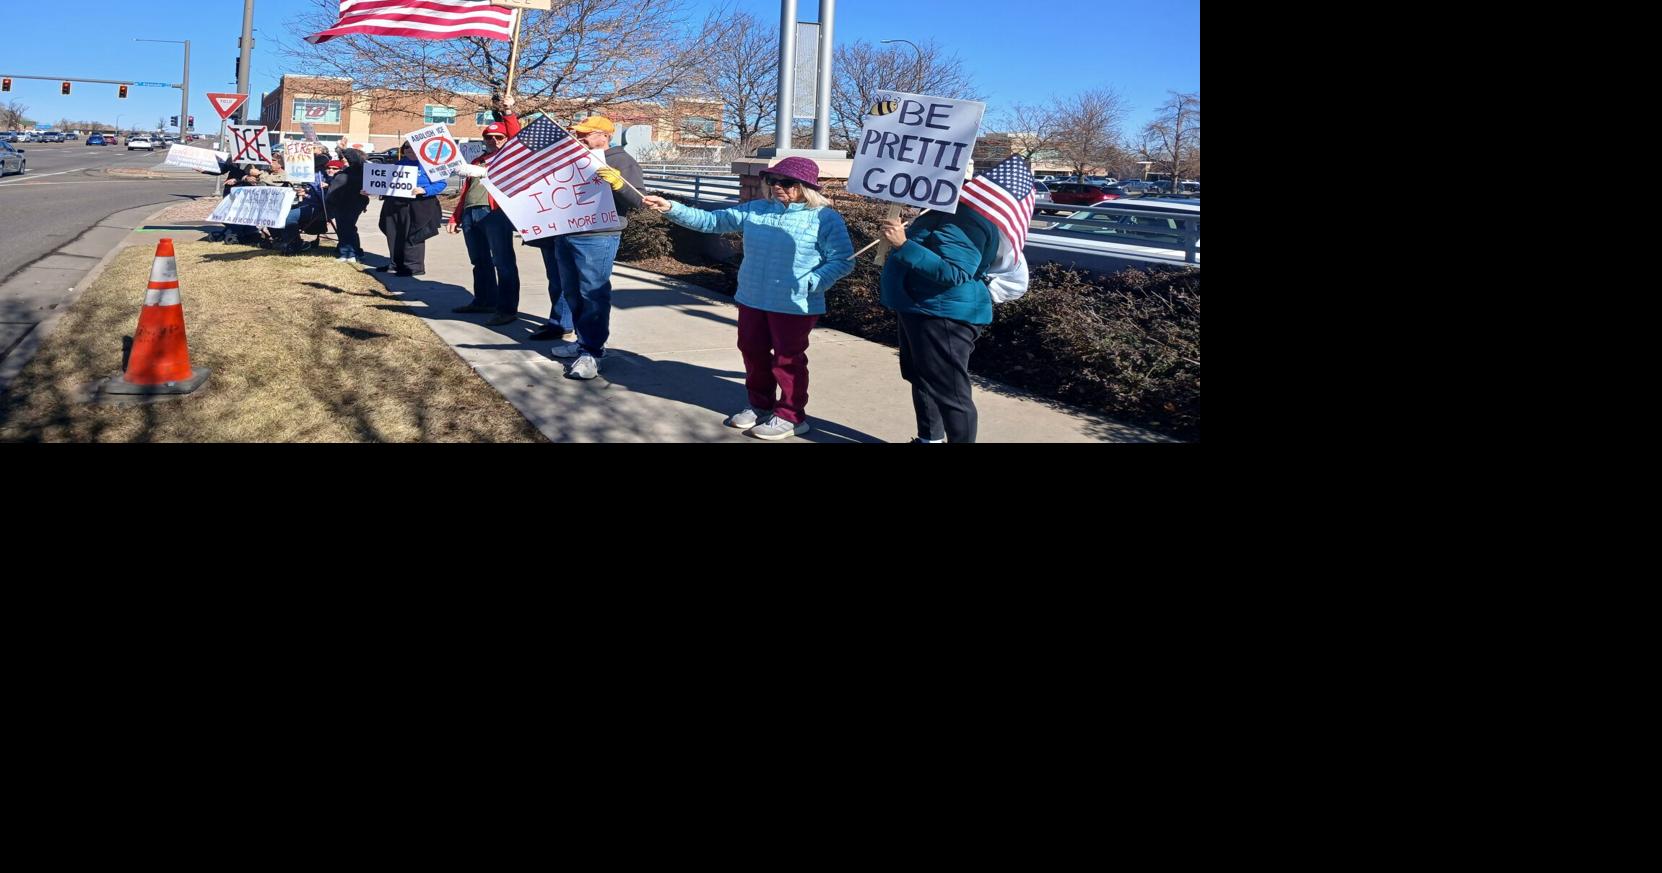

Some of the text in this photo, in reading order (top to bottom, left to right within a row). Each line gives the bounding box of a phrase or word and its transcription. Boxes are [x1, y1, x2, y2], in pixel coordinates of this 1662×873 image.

[898, 99, 954, 130] BE
[411, 126, 445, 142] ABOLISH ICE
[231, 128, 267, 162] ICE
[287, 142, 314, 155] FIRE
[860, 129, 968, 171] PRETTI
[290, 165, 310, 176] ICE
[371, 169, 387, 177] ICE
[543, 155, 591, 185] OP
[370, 180, 413, 190] FOR GOOD
[862, 167, 958, 206] GOOD
[548, 222, 557, 231] 4
[568, 214, 597, 229] MORE
[601, 210, 618, 224] DIE
